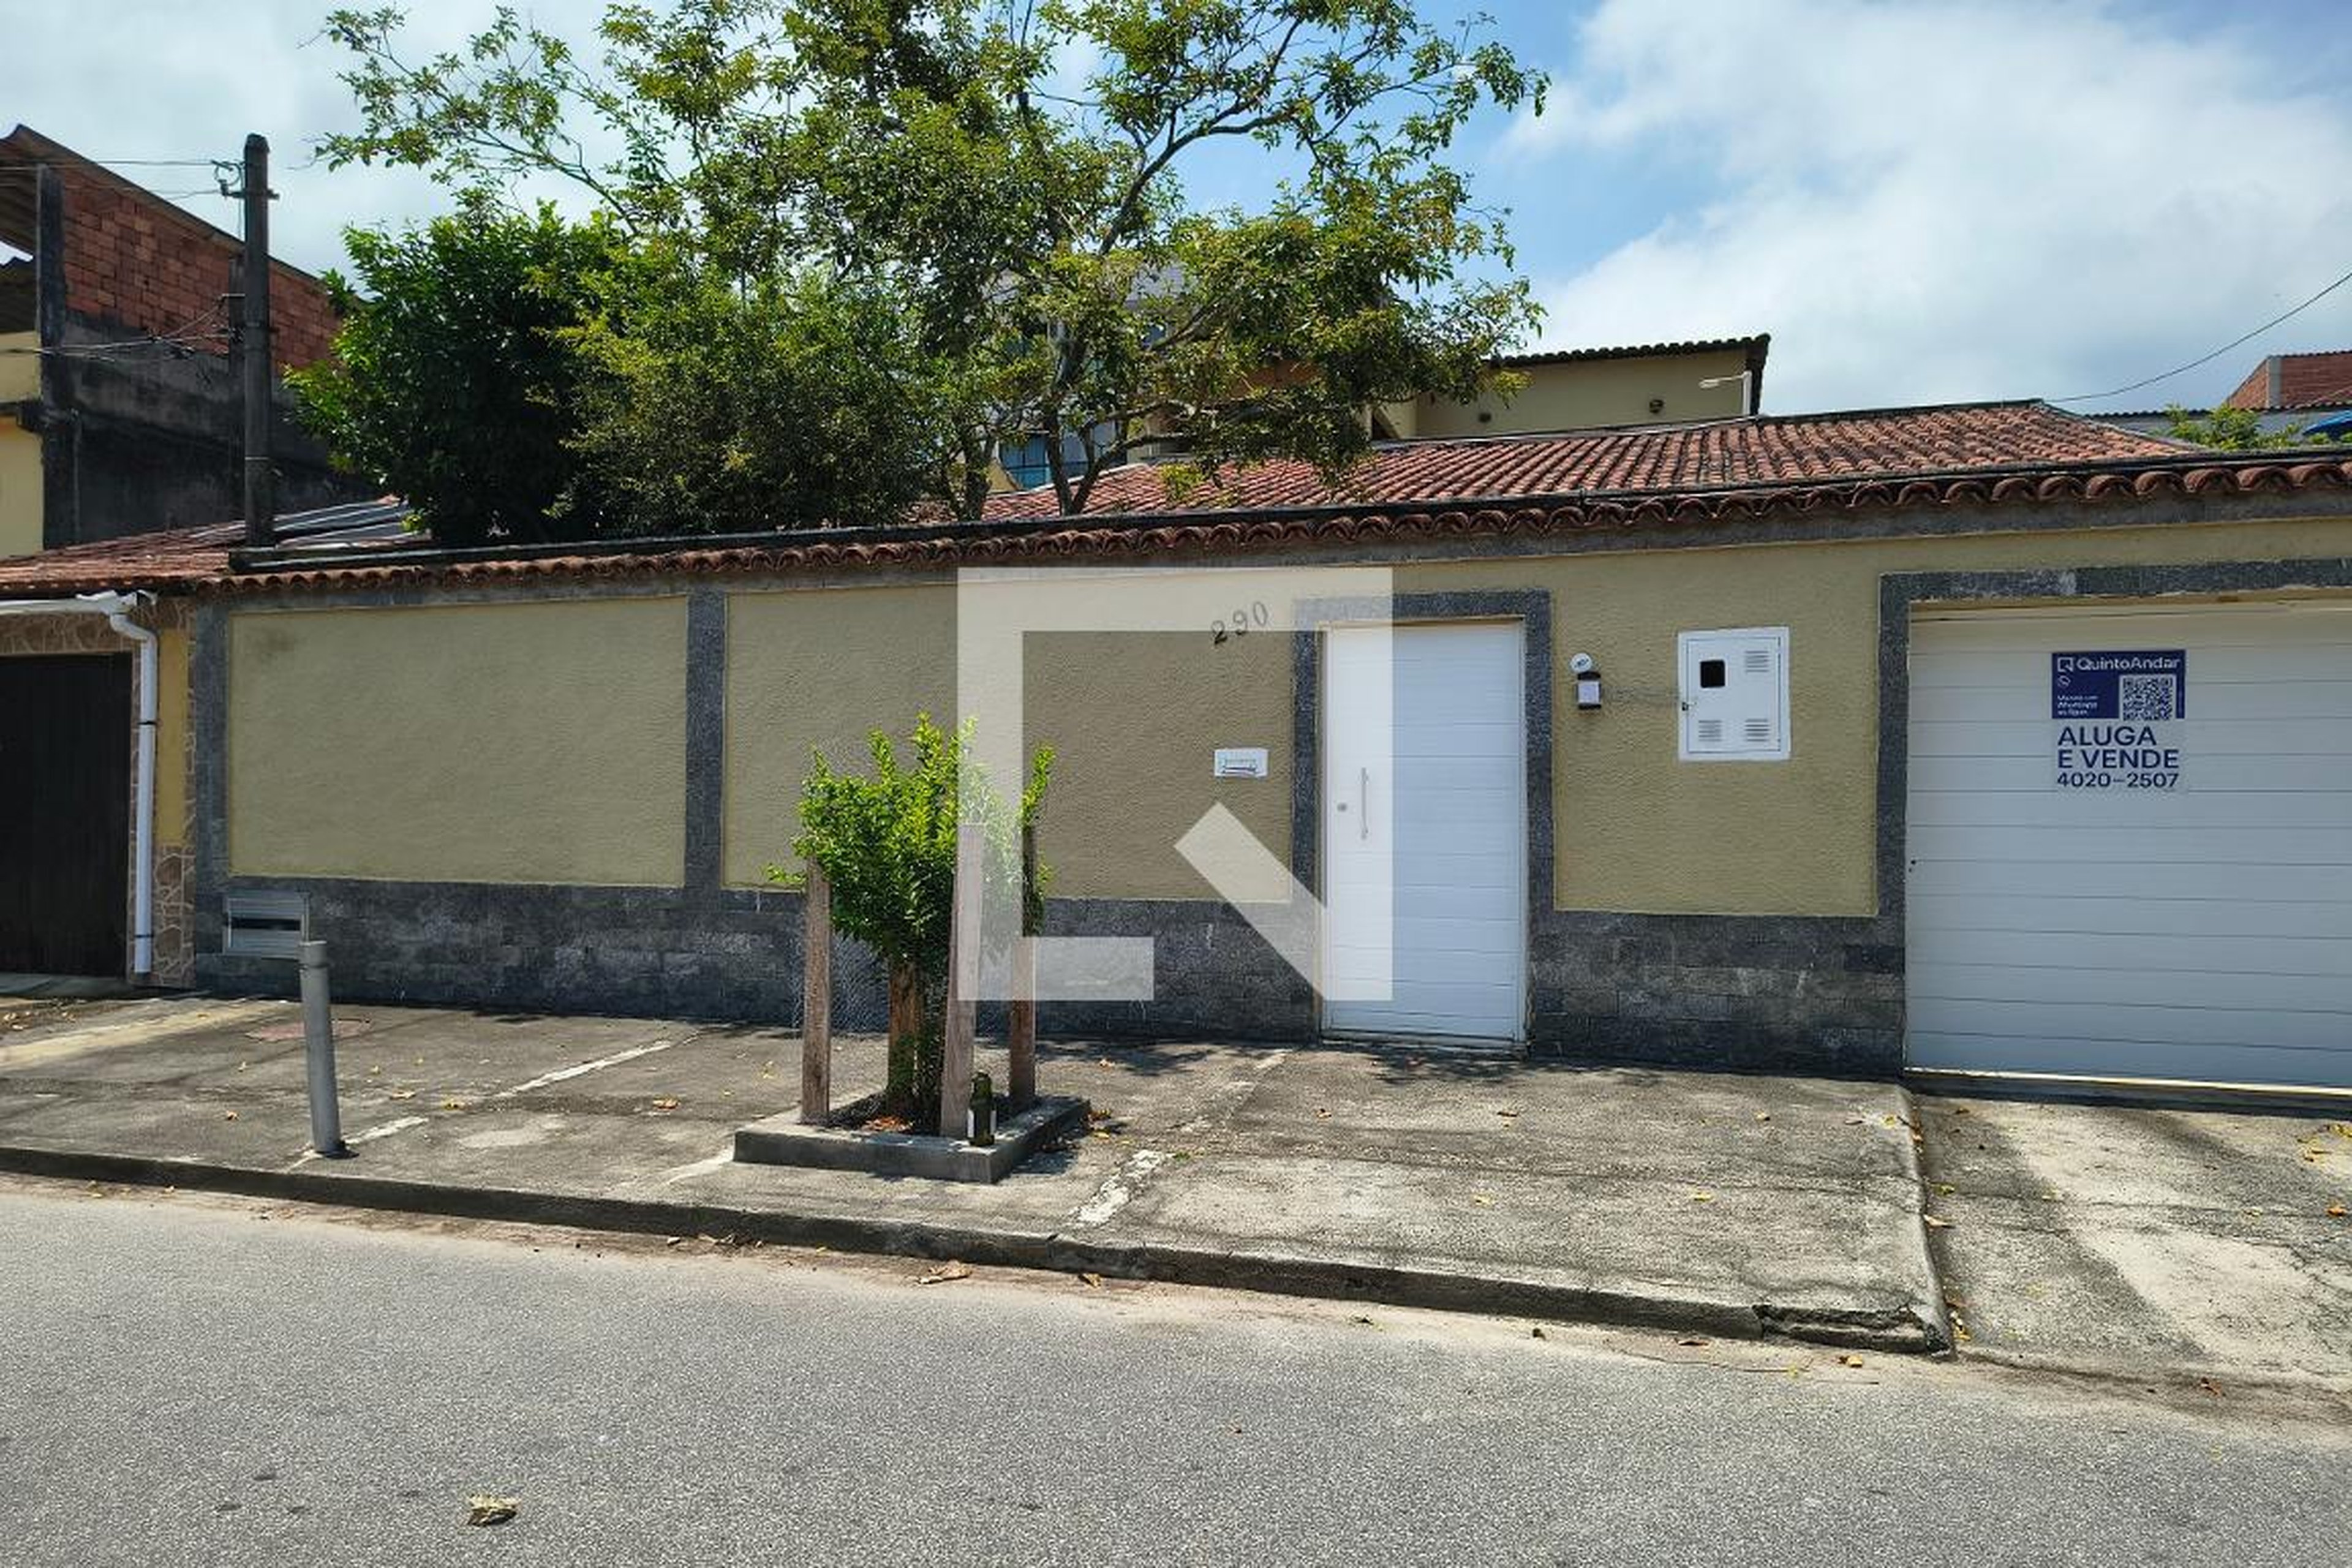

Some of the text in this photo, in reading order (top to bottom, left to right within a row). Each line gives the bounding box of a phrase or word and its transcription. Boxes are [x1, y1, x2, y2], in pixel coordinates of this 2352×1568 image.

[1211, 601, 1268, 645] 290
[2076, 657, 2181, 671] QuintoAndar
[2057, 726, 2157, 747] ALUGA
[2058, 749, 2179, 769] E VENDE
[2057, 772, 2179, 788] 4020-2507
